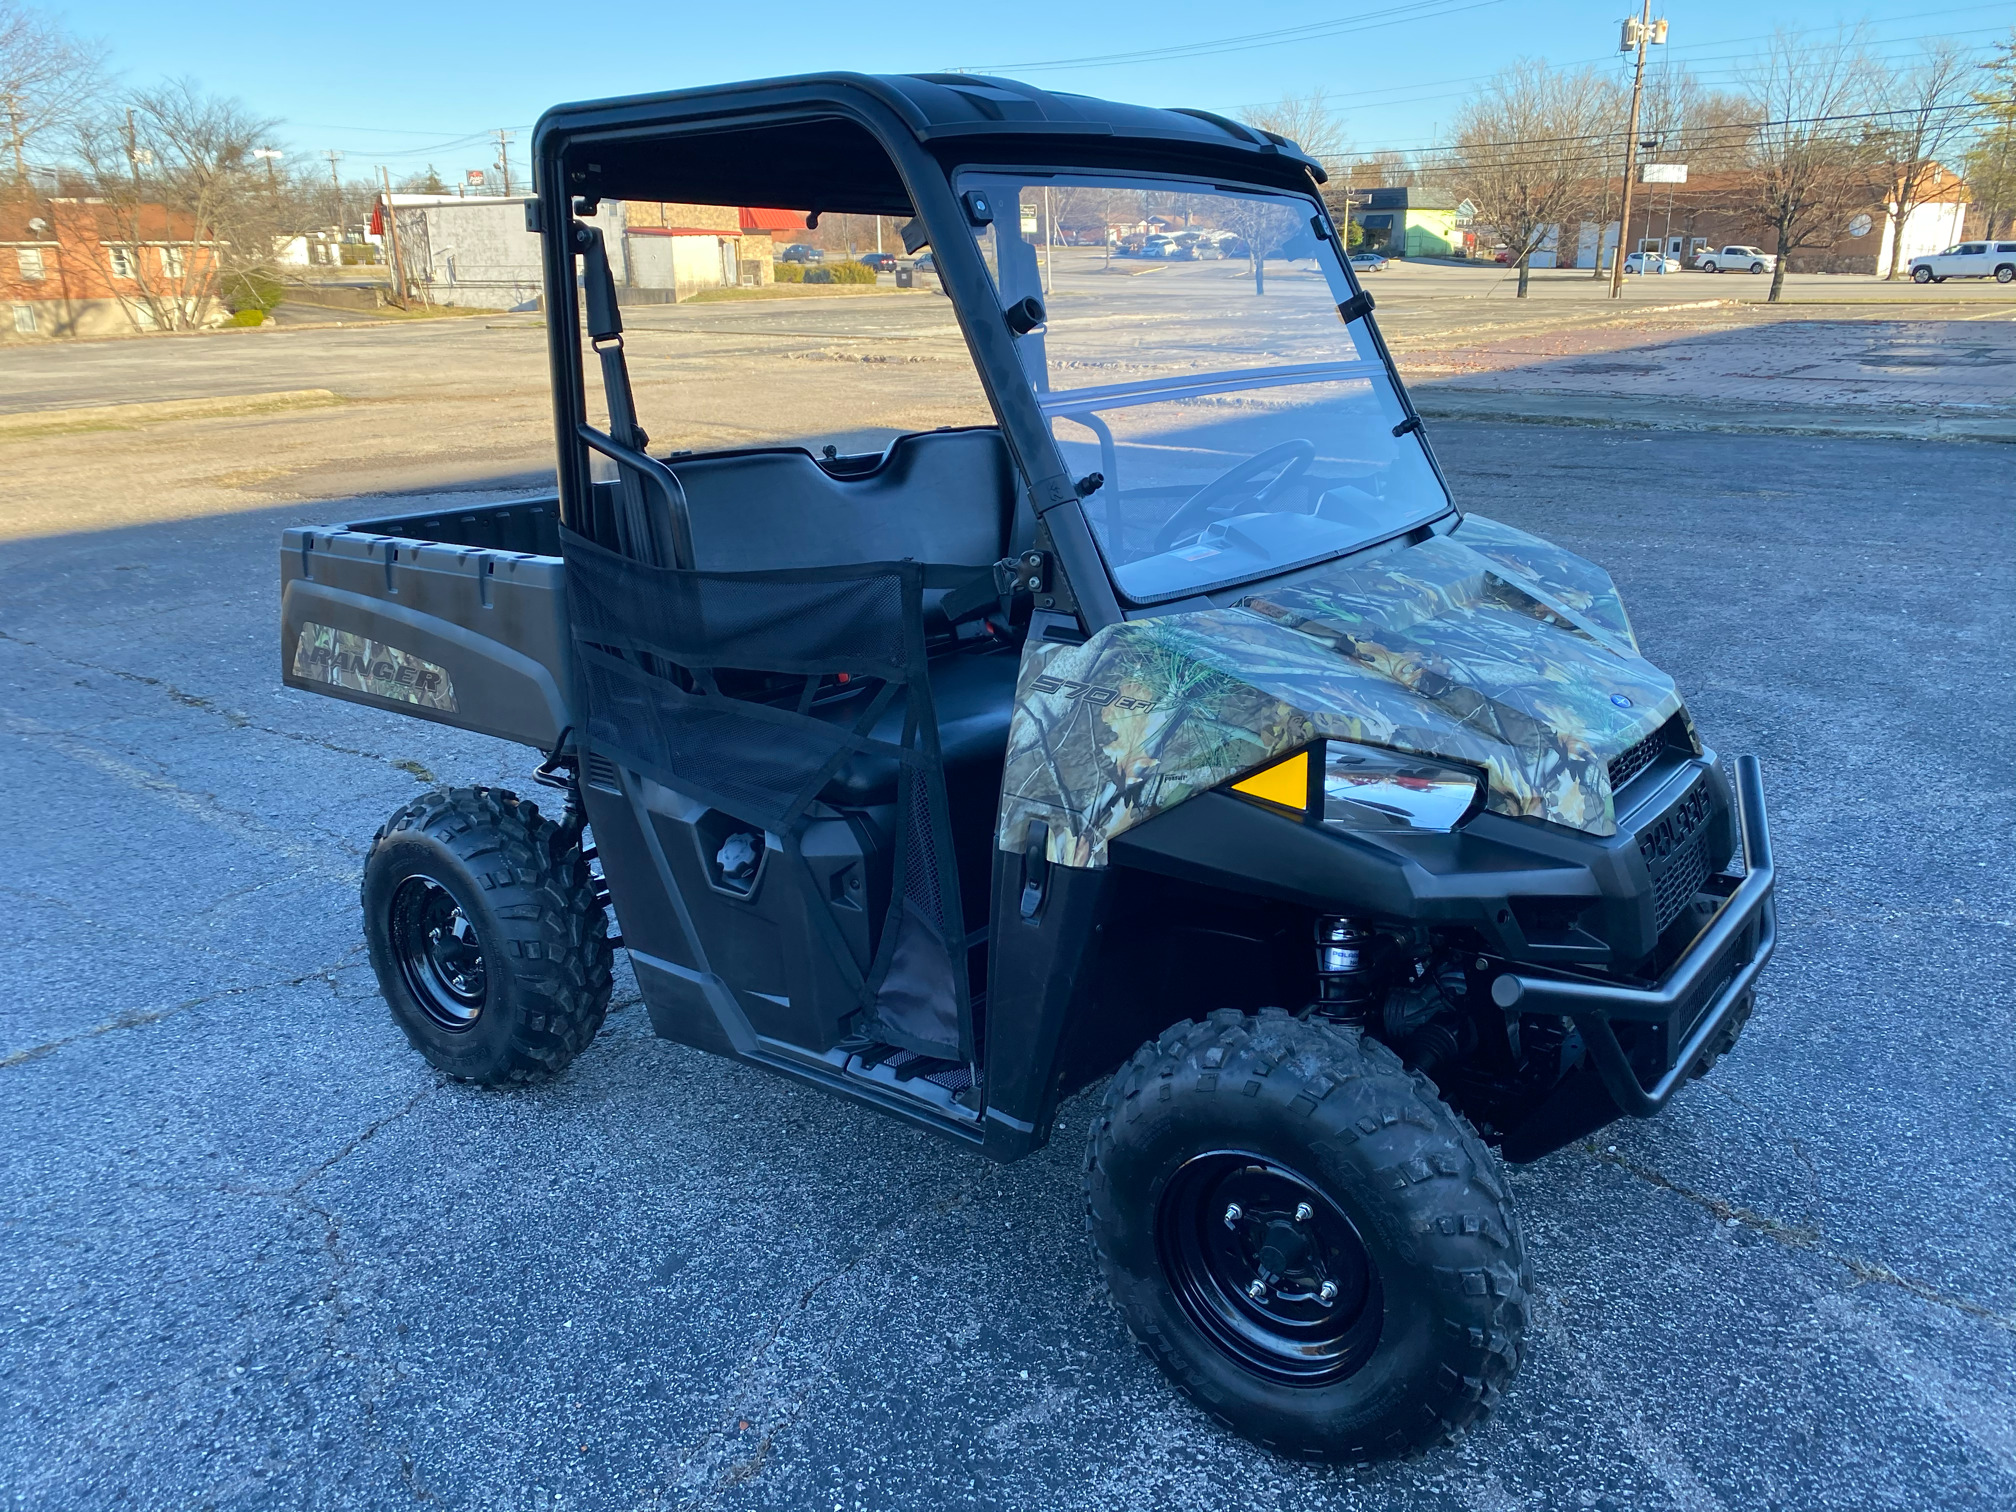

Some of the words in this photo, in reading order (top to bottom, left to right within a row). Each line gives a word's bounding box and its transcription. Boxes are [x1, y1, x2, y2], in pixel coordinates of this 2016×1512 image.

[310, 646, 442, 693] RANGER
[1029, 675, 1120, 707] 570
[1115, 696, 1157, 714] EFI
[1640, 779, 1712, 872] POLARIS
